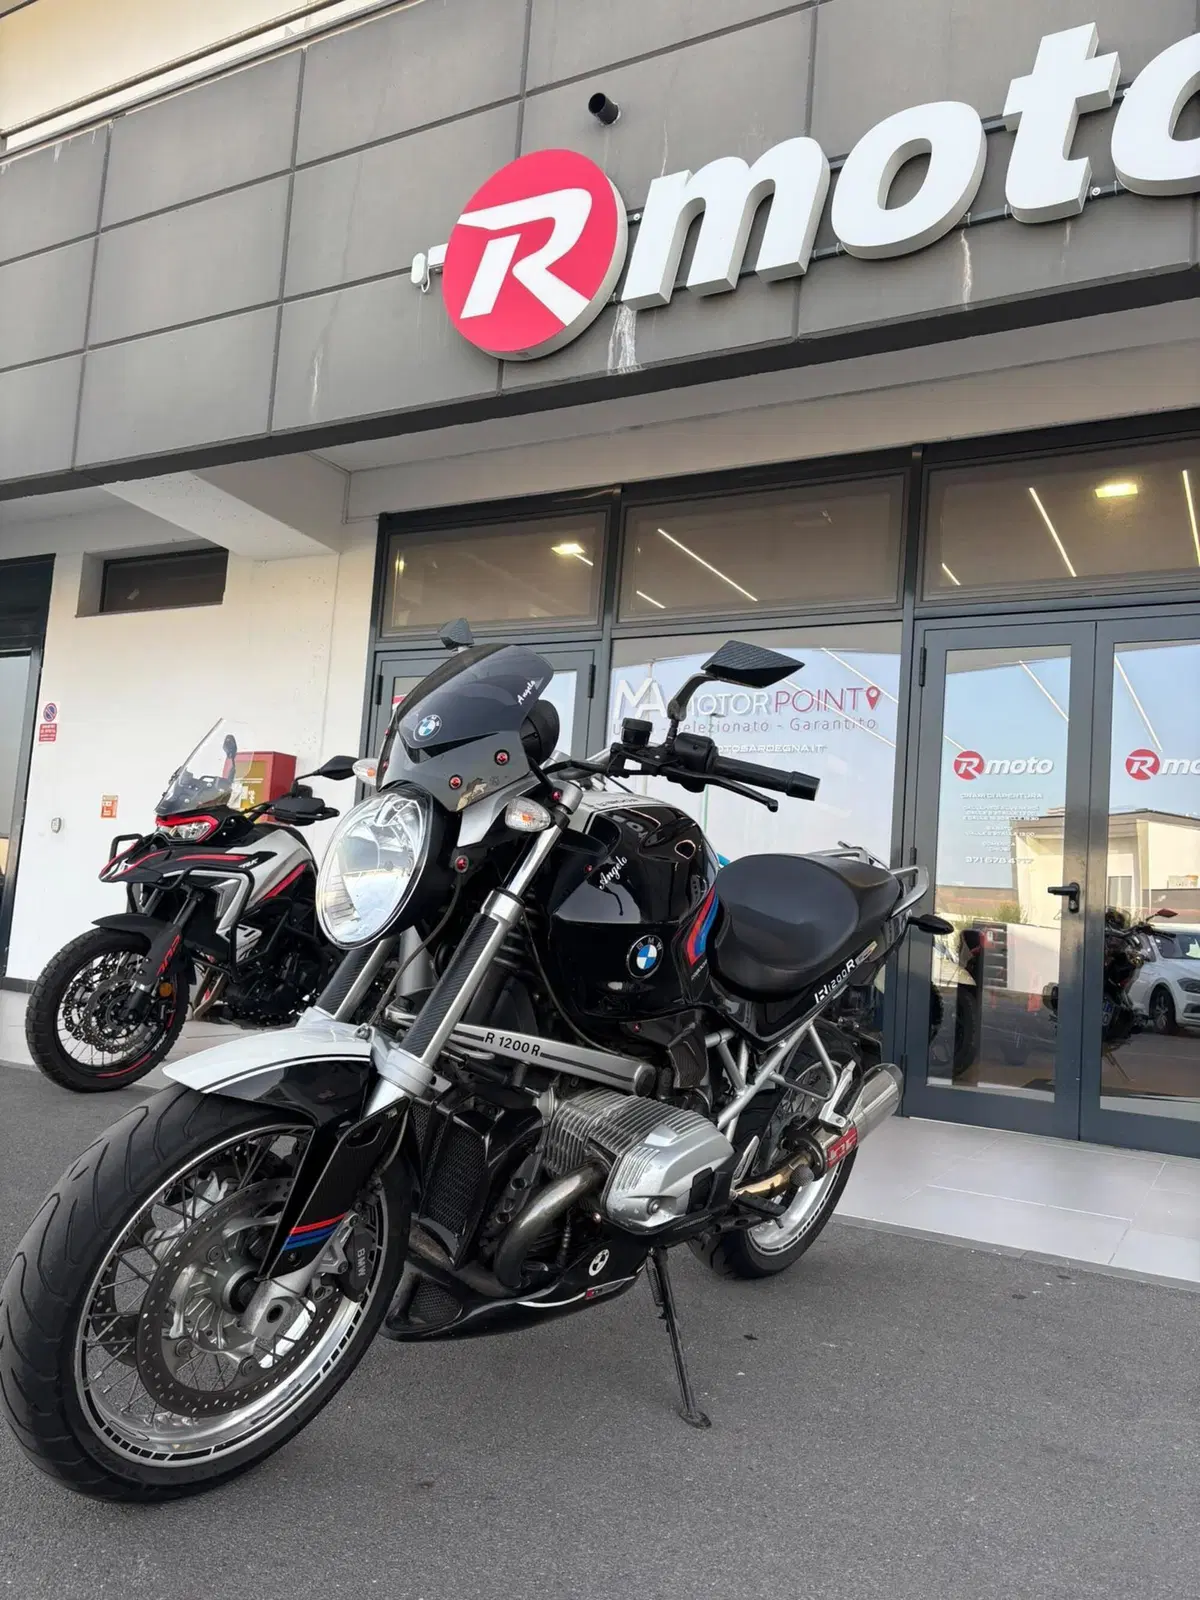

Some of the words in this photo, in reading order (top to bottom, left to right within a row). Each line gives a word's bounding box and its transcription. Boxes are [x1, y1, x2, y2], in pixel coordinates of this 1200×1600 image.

[789, 716, 877, 732] Garantito
[718, 743, 828, 754] OTOSARDEGNA.IT
[984, 756, 1054, 775] moto
[599, 855, 627, 890] Angelo
[485, 1032, 495, 1044] R
[357, 1247, 366, 1277] BMW
